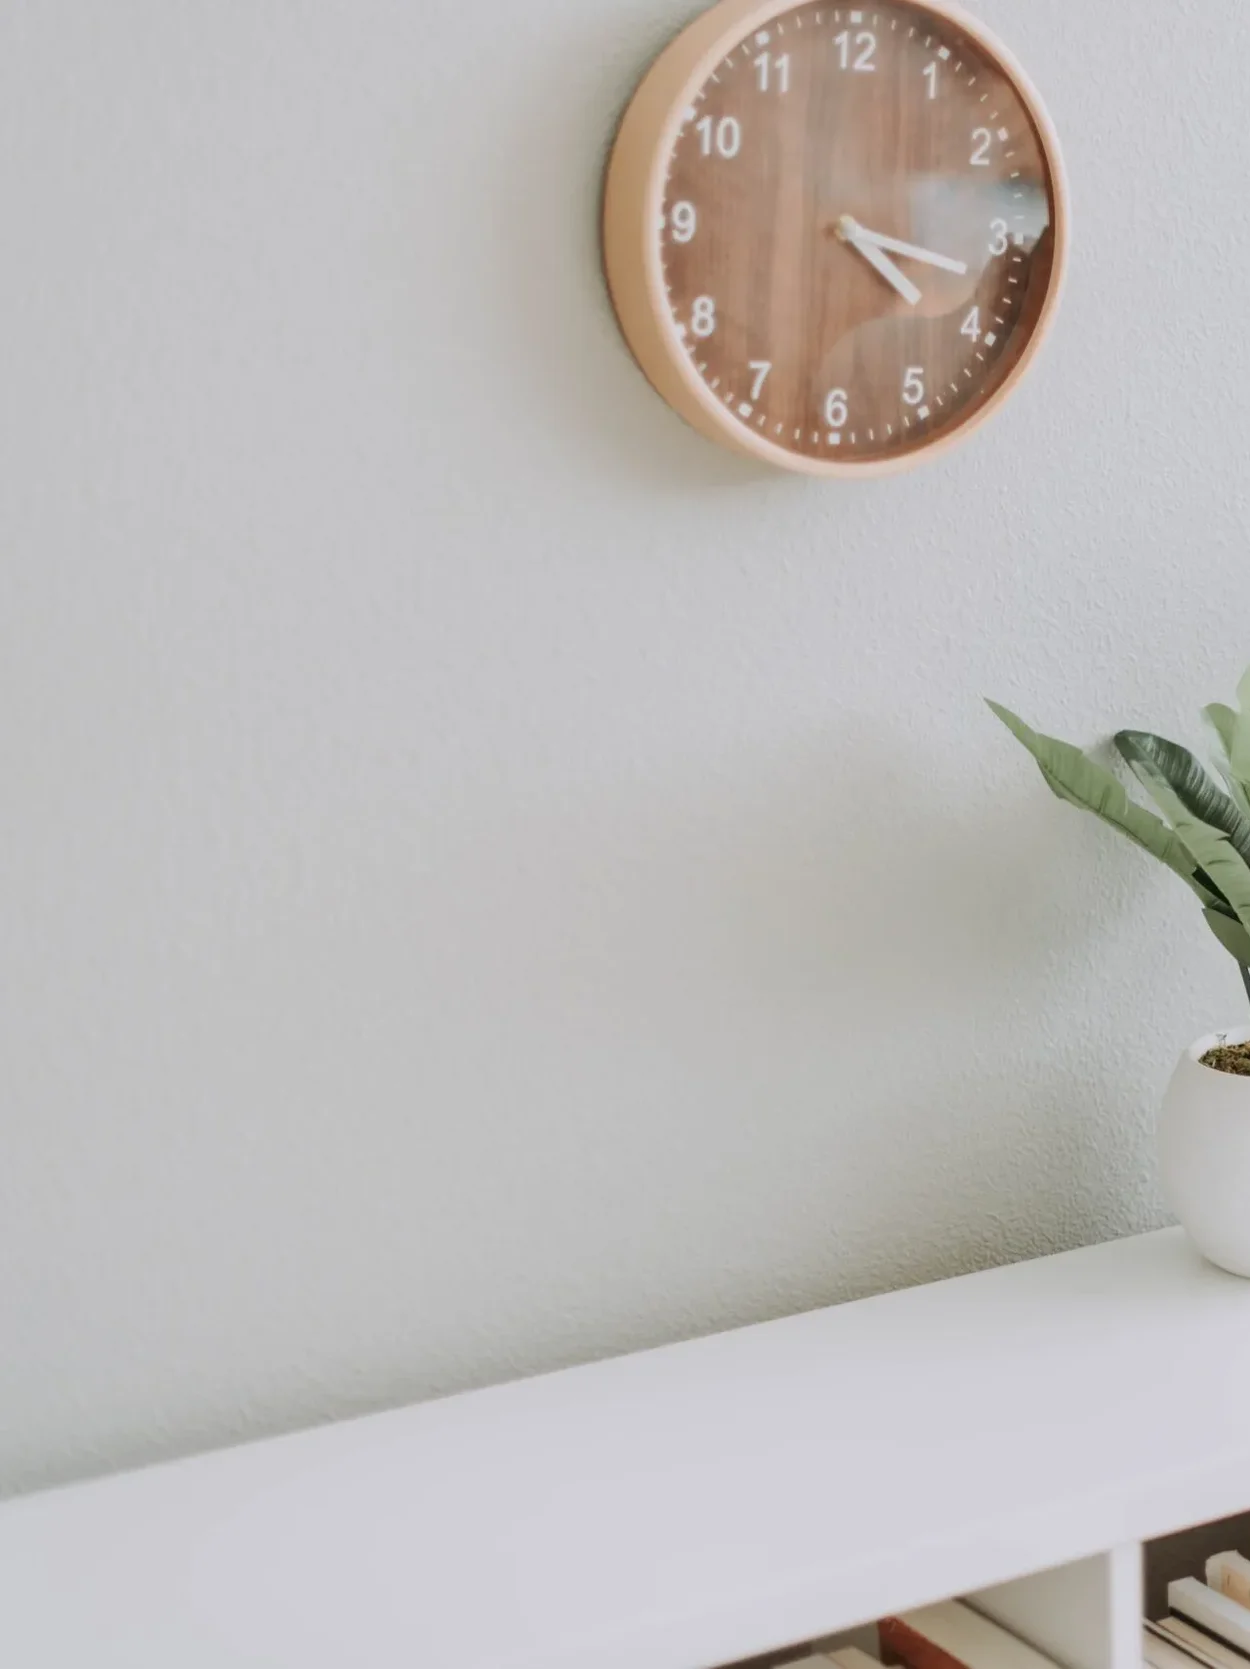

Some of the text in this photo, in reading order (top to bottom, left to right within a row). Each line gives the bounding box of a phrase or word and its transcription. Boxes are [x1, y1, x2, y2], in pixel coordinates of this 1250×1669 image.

[833, 31, 876, 71] 12
[753, 52, 791, 93] 11
[922, 61, 938, 99] 1
[696, 115, 741, 158] 10
[969, 127, 992, 165] 2
[672, 201, 696, 243] 9
[988, 218, 1008, 256] 3
[691, 295, 716, 337] 8
[960, 305, 981, 342] 4
[749, 360, 772, 400] 7
[903, 367, 925, 404] 5
[824, 388, 848, 427] 6
